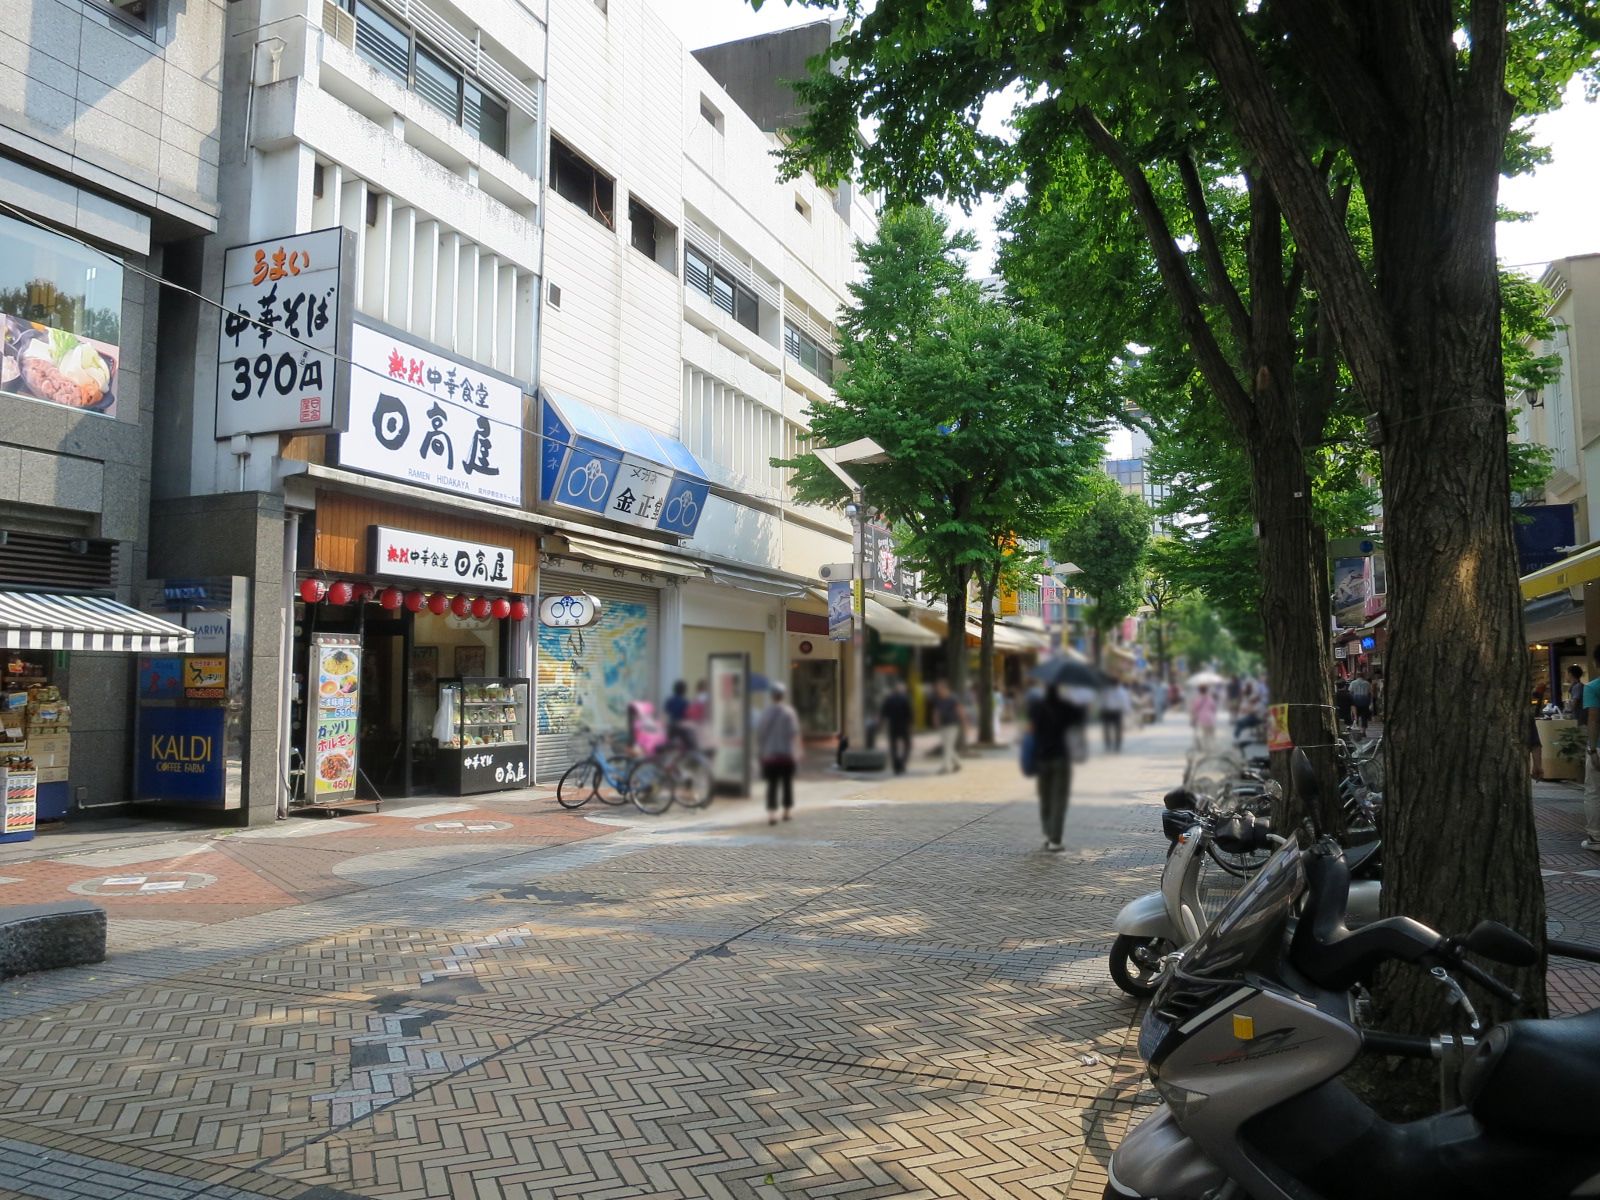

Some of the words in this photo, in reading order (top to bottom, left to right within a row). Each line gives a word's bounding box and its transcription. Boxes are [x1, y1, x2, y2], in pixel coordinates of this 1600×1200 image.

[252, 246, 310, 286] うまい
[225, 283, 335, 349] 中華そば
[231, 352, 323, 401] 390円
[388, 347, 489, 408] 熱烈中華食堂
[372, 392, 500, 476] 日高屋
[547, 423, 561, 471] メガネ
[408, 468, 430, 481] RAMEN
[437, 474, 470, 491] HIDAKAYA
[630, 468, 658, 486] メガネ
[612, 487, 664, 521] 金正堂
[387, 544, 449, 568] 熱烈中華食堂
[454, 549, 508, 582] 日高屋
[317, 733, 356, 752] ホルモン
[318, 720, 349, 739] ガッツリ
[151, 734, 212, 762] KALDI
[156, 761, 182, 773] COFFEE
[184, 762, 205, 774] FARM
[494, 761, 528, 784] 日高屋
